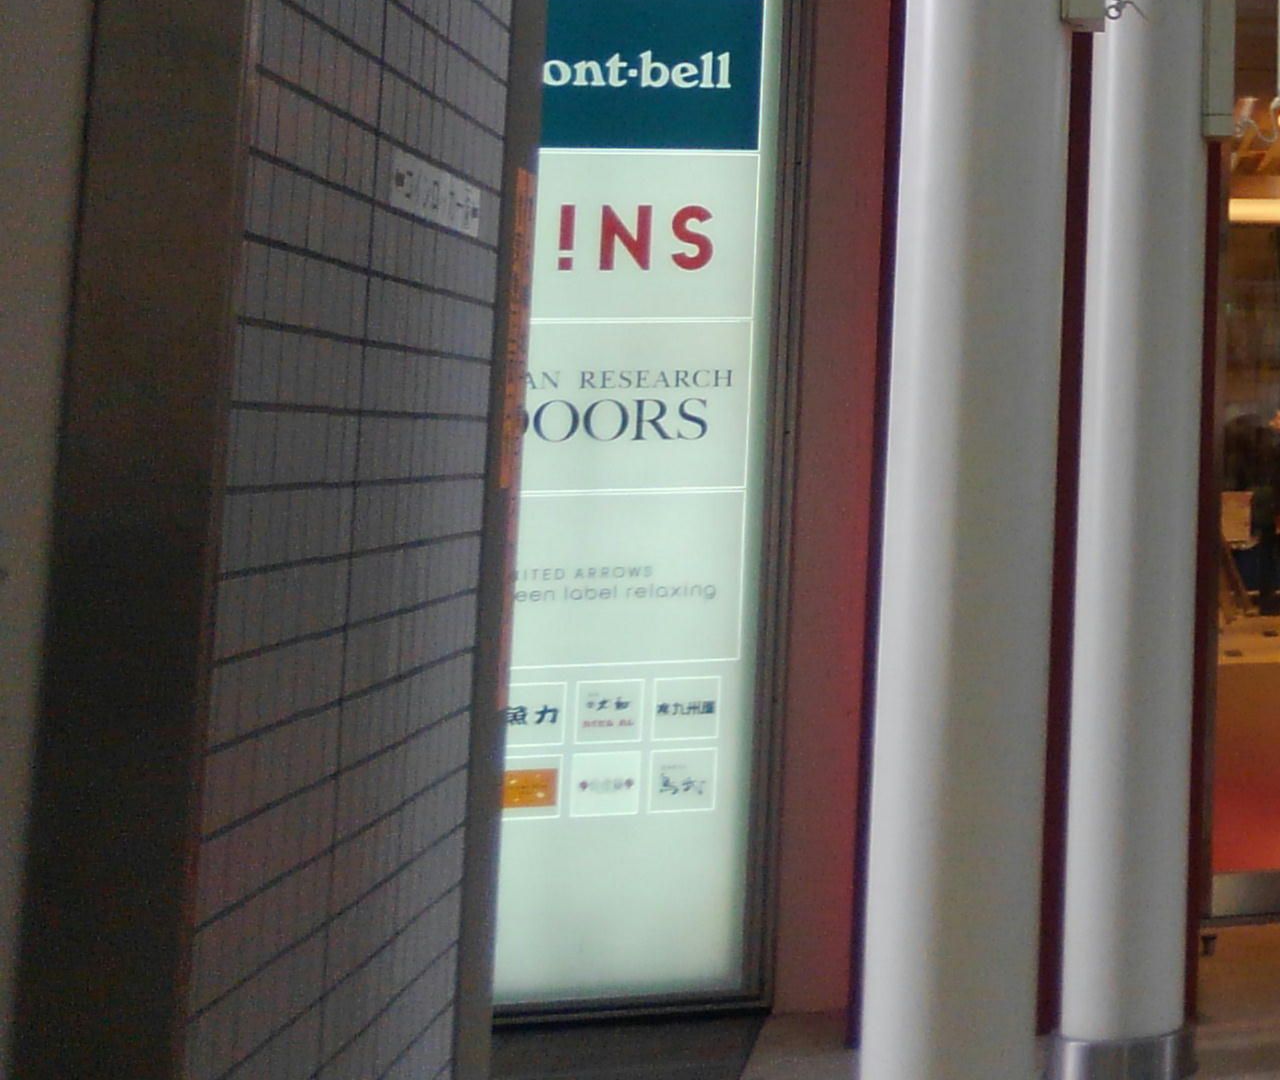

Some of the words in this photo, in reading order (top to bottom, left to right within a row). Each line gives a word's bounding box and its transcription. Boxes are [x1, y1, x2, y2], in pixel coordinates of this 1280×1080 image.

[579, 368, 733, 390] RESEARCH
[518, 397, 708, 443] OORS
[574, 565, 654, 581] ARROWS
[563, 584, 618, 601] label
[625, 582, 717, 602] relaxing
